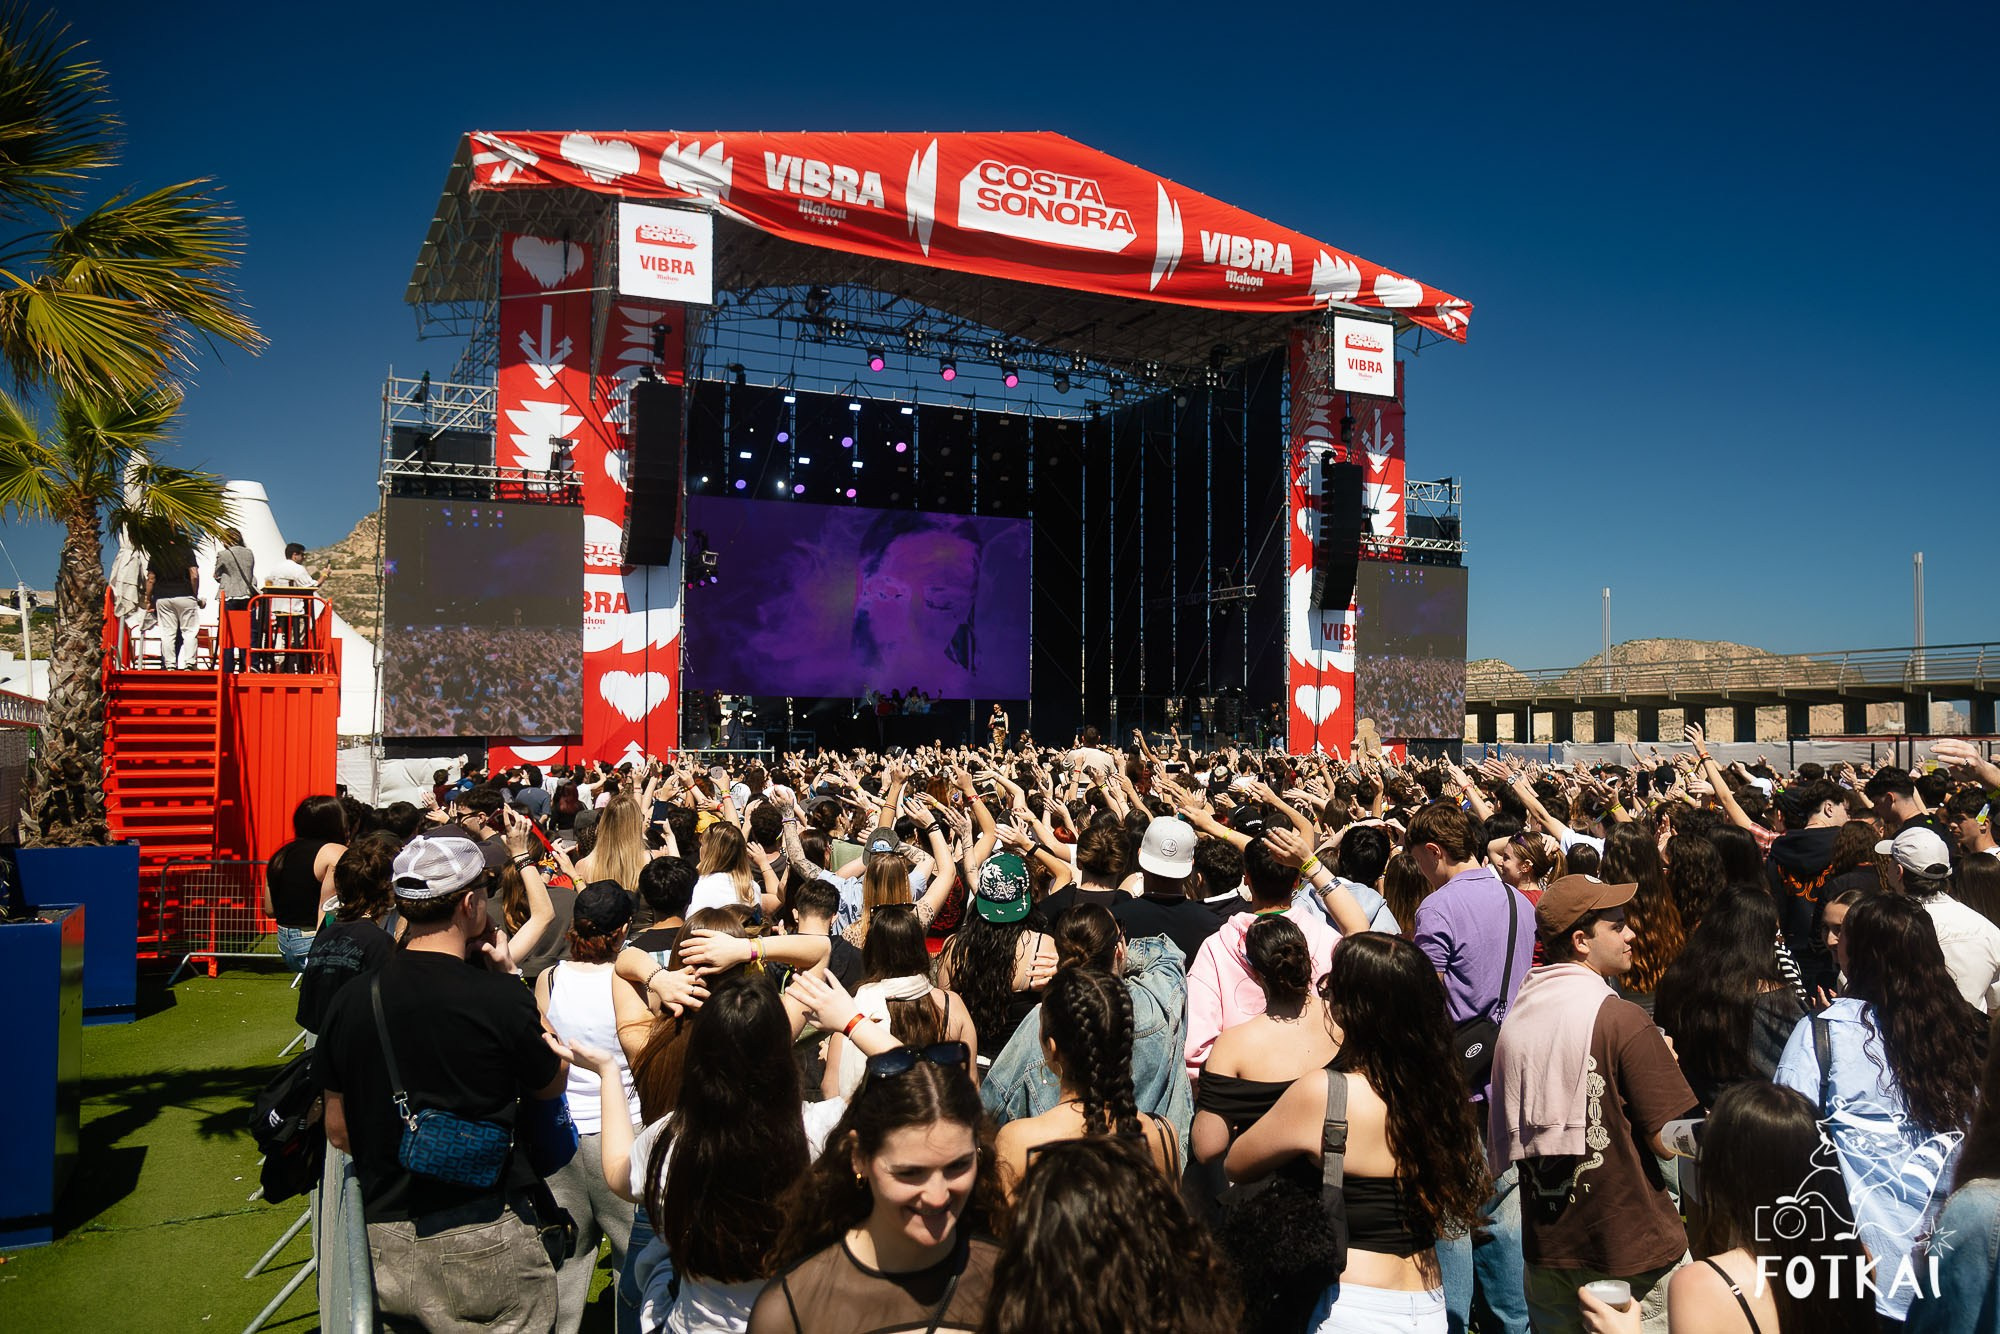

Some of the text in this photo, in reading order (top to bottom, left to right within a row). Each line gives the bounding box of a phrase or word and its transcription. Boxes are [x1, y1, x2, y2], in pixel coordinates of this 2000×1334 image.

[763, 151, 885, 209] VIBRA
[979, 162, 1104, 205] COSTA
[798, 199, 847, 219] Mahou
[976, 187, 1134, 234] SONORA
[639, 230, 698, 246] SONORA
[641, 224, 688, 236] COSTA
[1200, 229, 1293, 276] VIBRA
[639, 254, 695, 276] VIBRA
[1225, 269, 1264, 287] Mahou
[1347, 358, 1383, 373] VIBRA
[583, 542, 620, 555] STA
[583, 591, 631, 614] BRA
[583, 616, 606, 625] ahou
[1322, 623, 1356, 641] VIB
